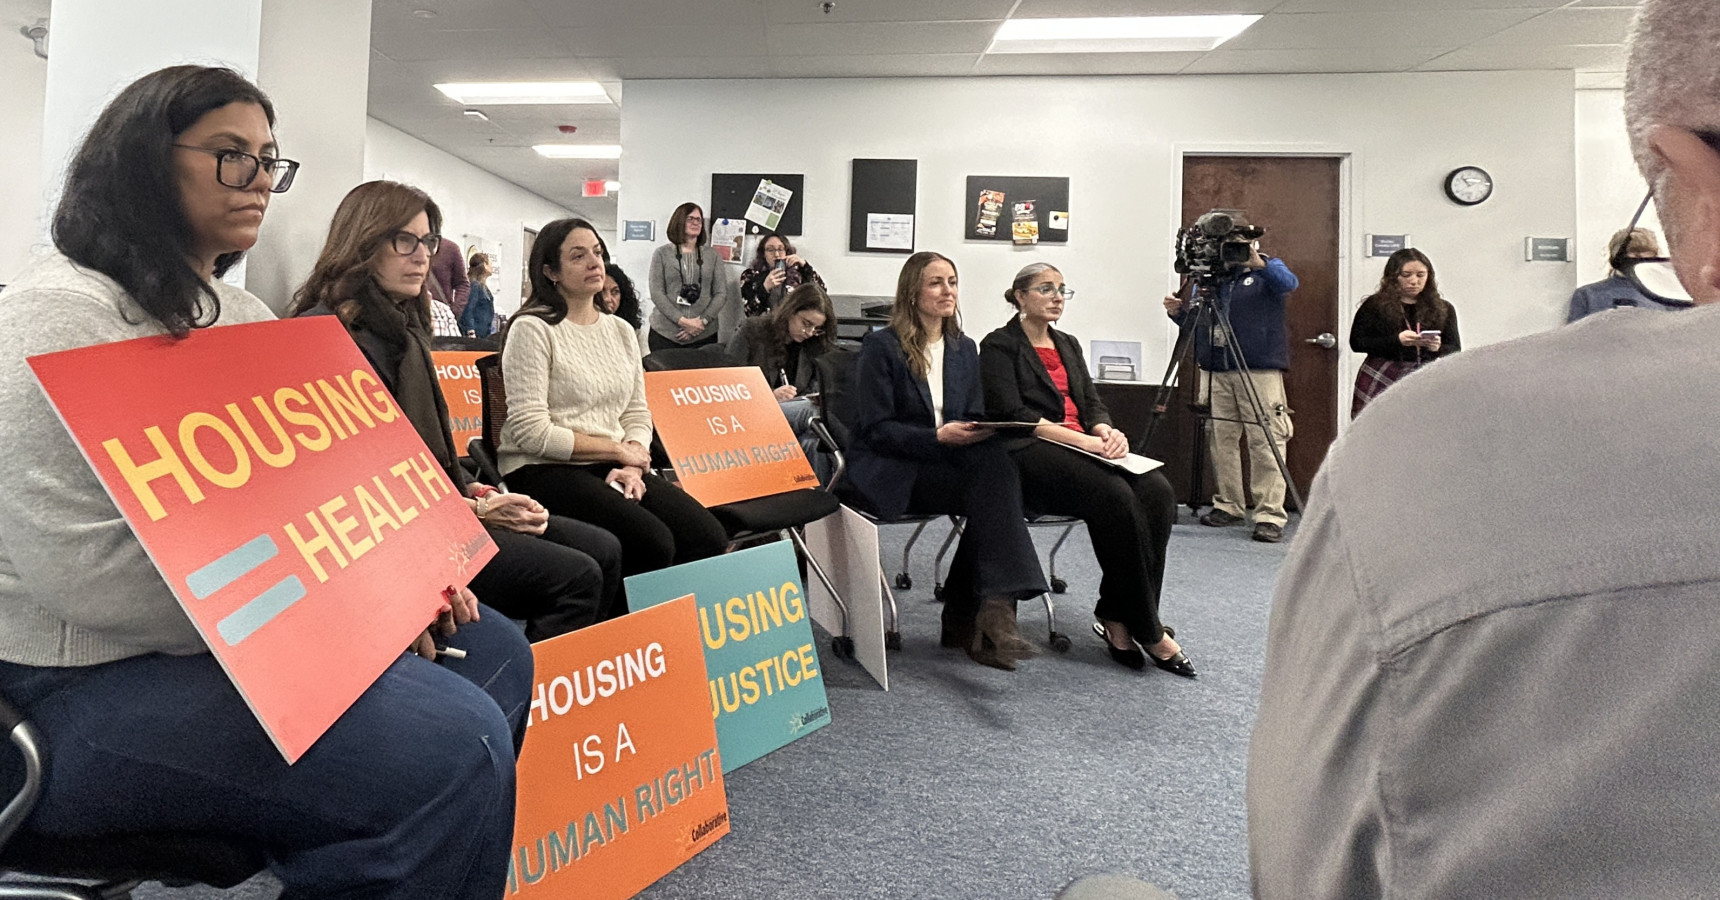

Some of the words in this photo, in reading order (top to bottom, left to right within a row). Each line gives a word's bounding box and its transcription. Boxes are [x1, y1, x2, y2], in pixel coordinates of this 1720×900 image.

[434, 365, 481, 380] HOUS
[463, 389, 482, 405] IS
[670, 383, 752, 407] HOUSING
[102, 369, 400, 522] HOUSING
[706, 415, 727, 436] IS
[731, 414, 746, 433] A
[675, 447, 752, 478] HUMAN
[751, 440, 802, 465] RIGHT
[283, 451, 451, 584] HEALTH
[699, 581, 805, 650] USING
[526, 642, 667, 728] HOUSING
[573, 734, 605, 781] IS
[614, 722, 637, 763] A
[634, 747, 718, 824] RIGHT
